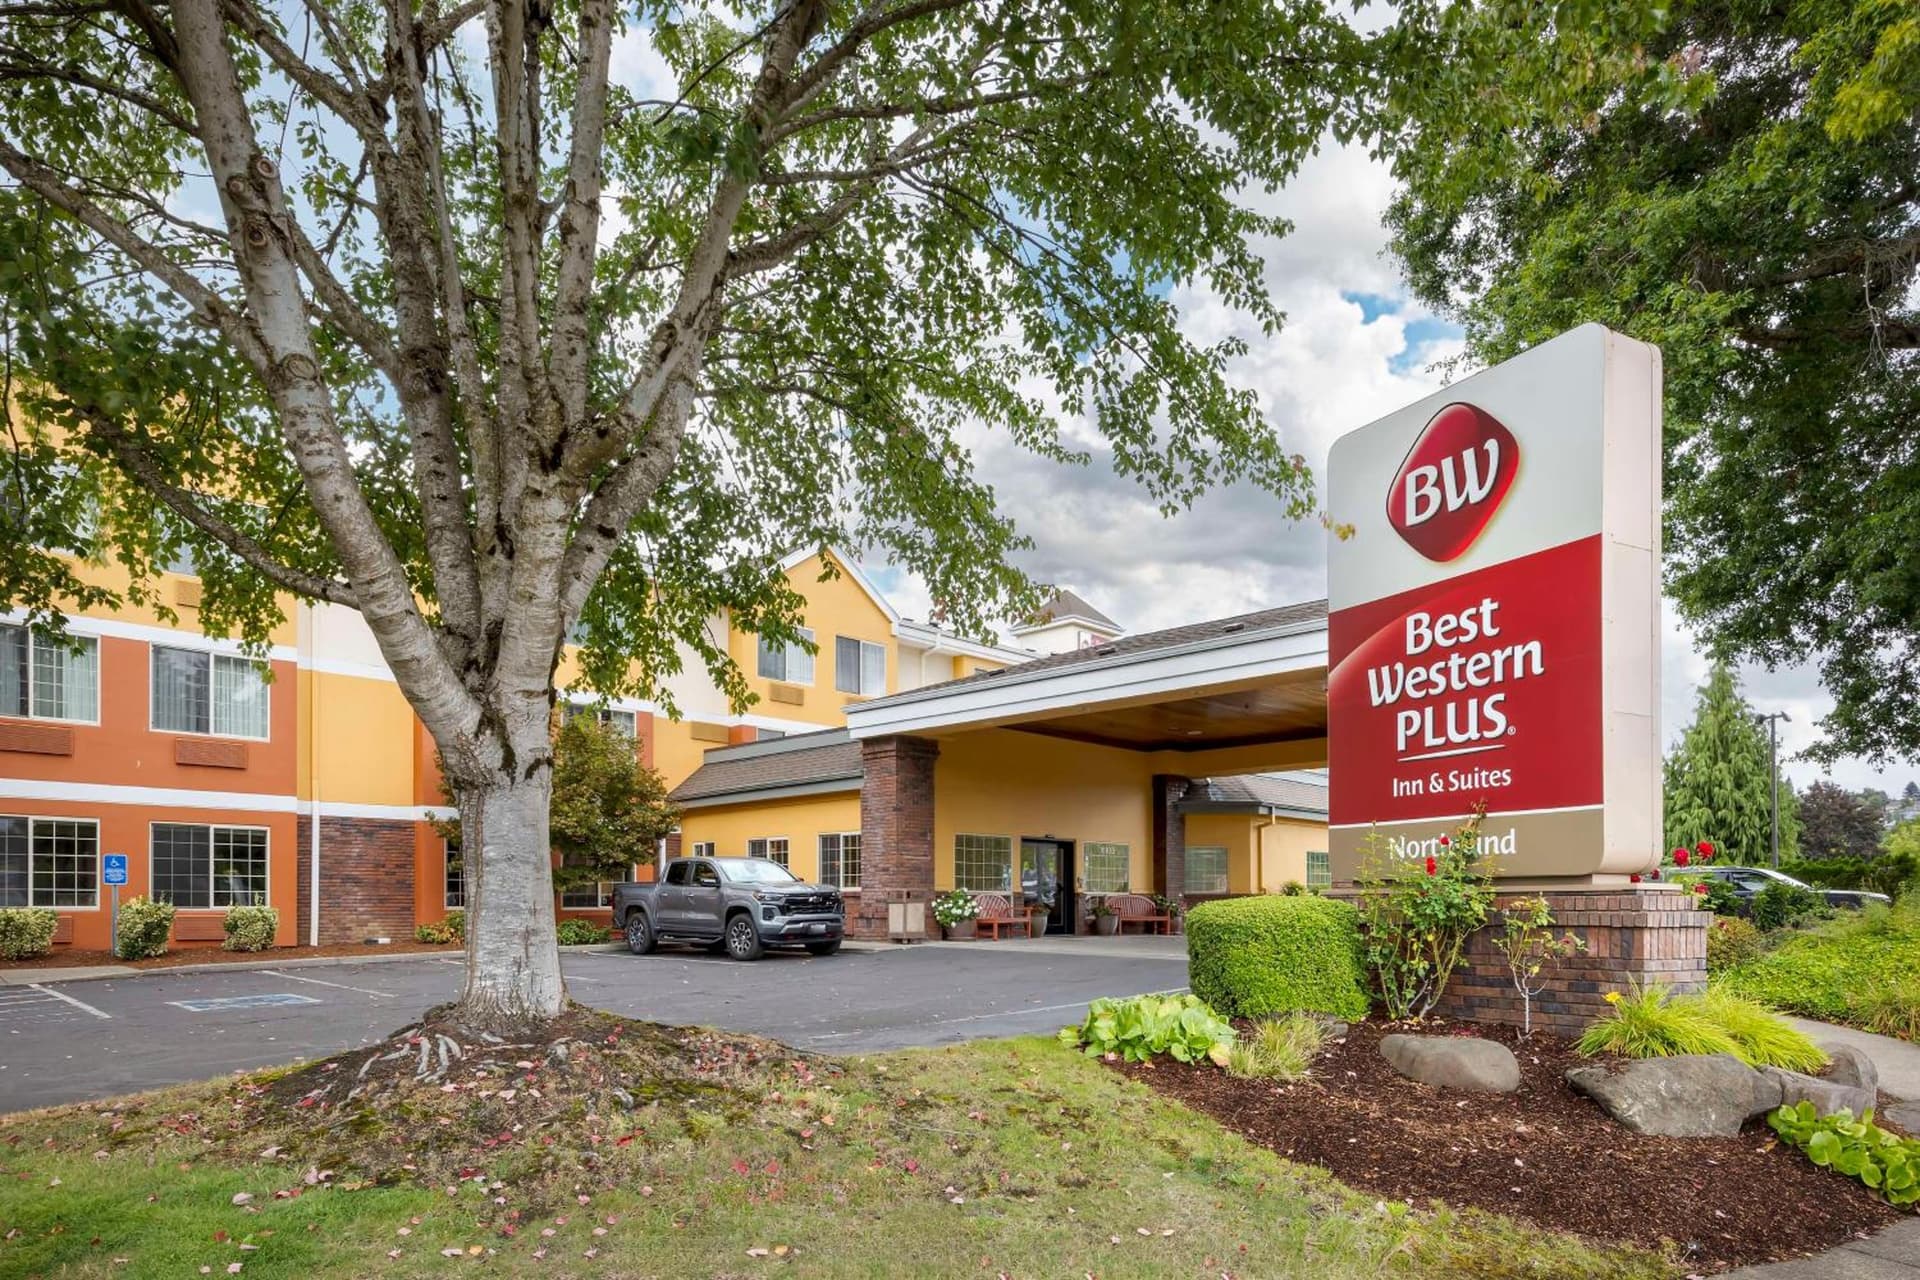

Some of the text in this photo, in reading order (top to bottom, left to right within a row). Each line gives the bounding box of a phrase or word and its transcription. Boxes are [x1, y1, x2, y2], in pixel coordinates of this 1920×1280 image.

[1405, 438, 1499, 527] BW
[1406, 598, 1499, 656] Best
[1367, 640, 1544, 707] Western
[1393, 767, 1512, 797] Inn & Suites
[1389, 828, 1517, 860] Nortind
